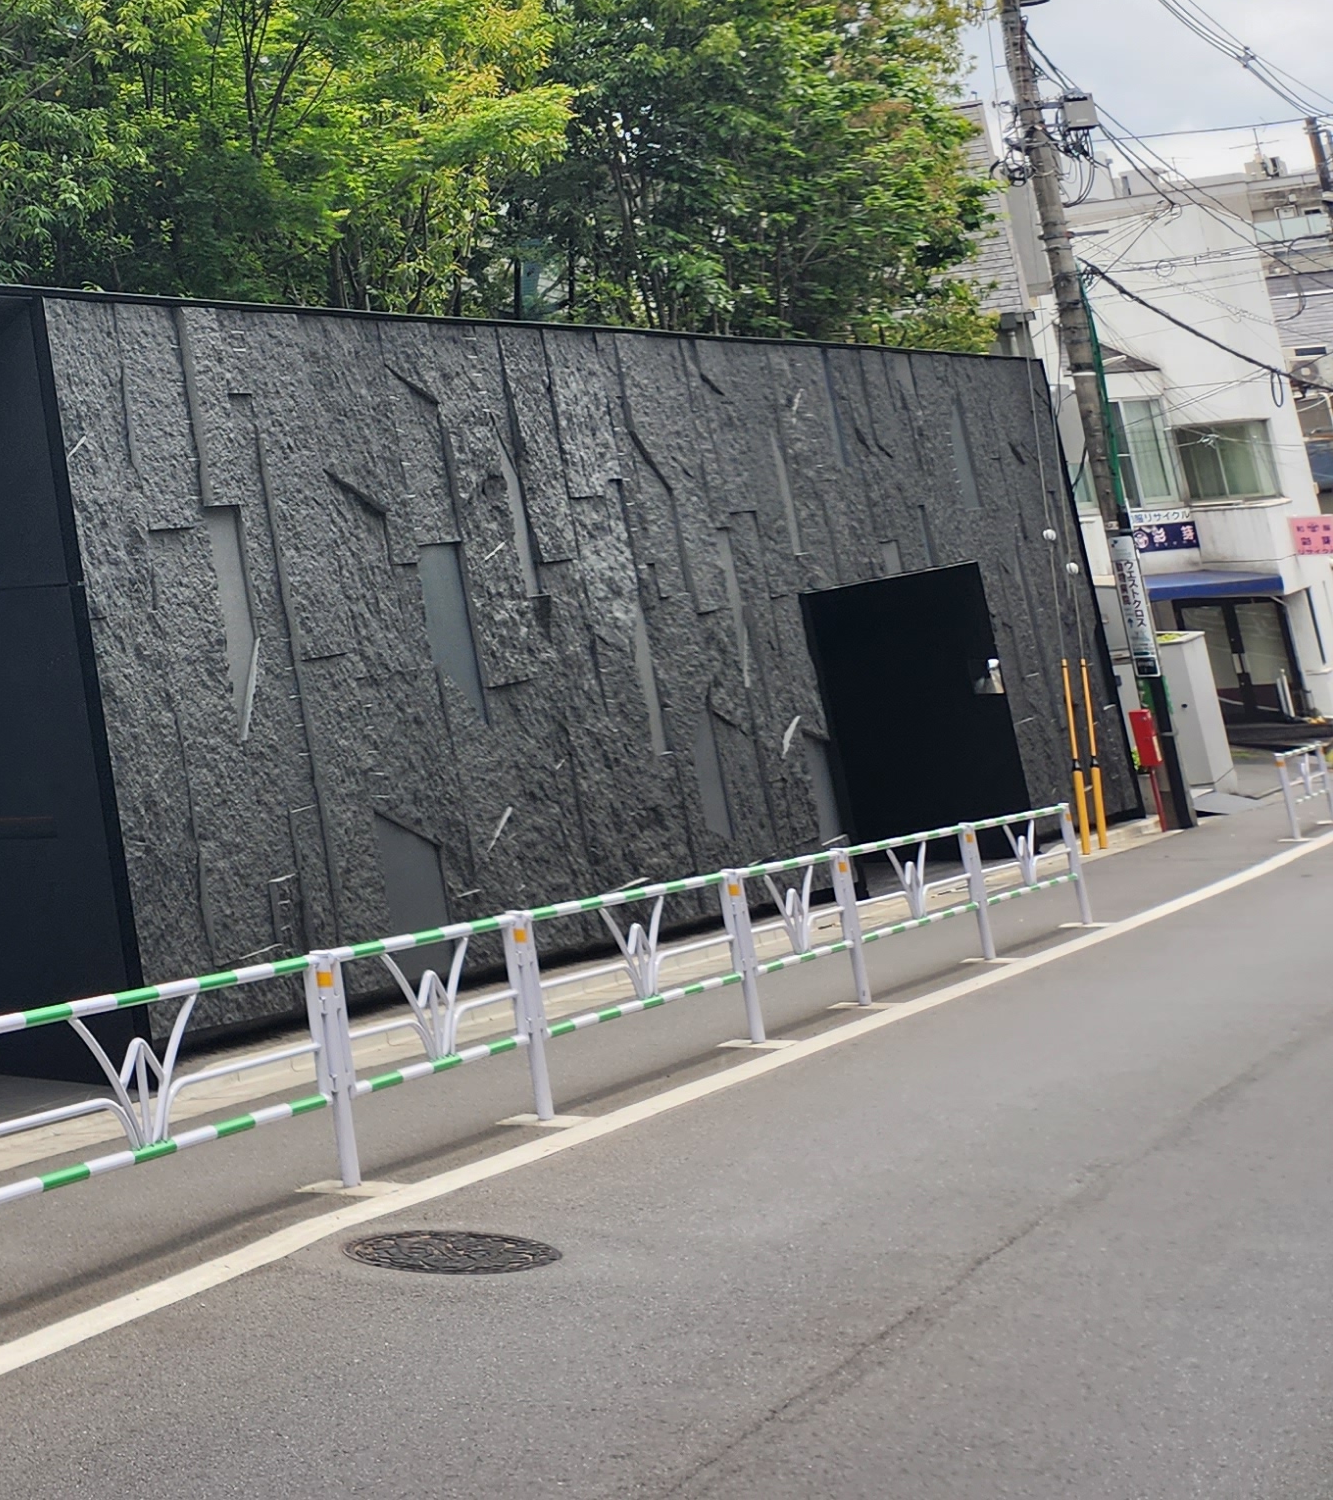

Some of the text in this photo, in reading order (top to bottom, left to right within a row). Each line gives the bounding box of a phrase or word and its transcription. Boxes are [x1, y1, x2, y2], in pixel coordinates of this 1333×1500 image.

[1124, 560, 1147, 627] ウエストクロス
